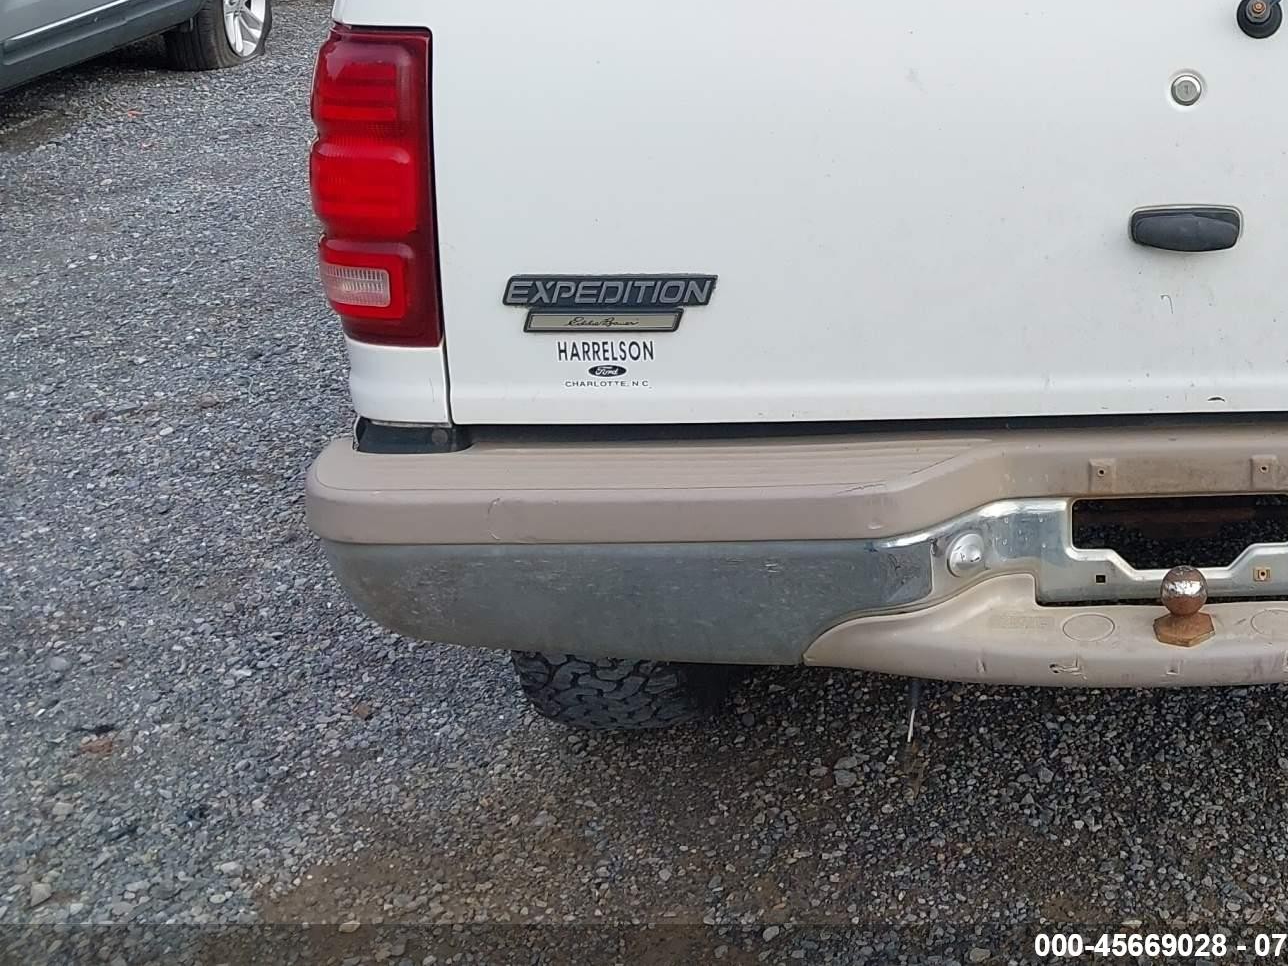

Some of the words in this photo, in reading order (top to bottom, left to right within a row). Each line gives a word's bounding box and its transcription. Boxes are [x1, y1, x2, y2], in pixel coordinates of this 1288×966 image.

[505, 280, 713, 305] EXPEDITION
[557, 340, 655, 362] HARRELSON
[594, 366, 619, 376] Ford
